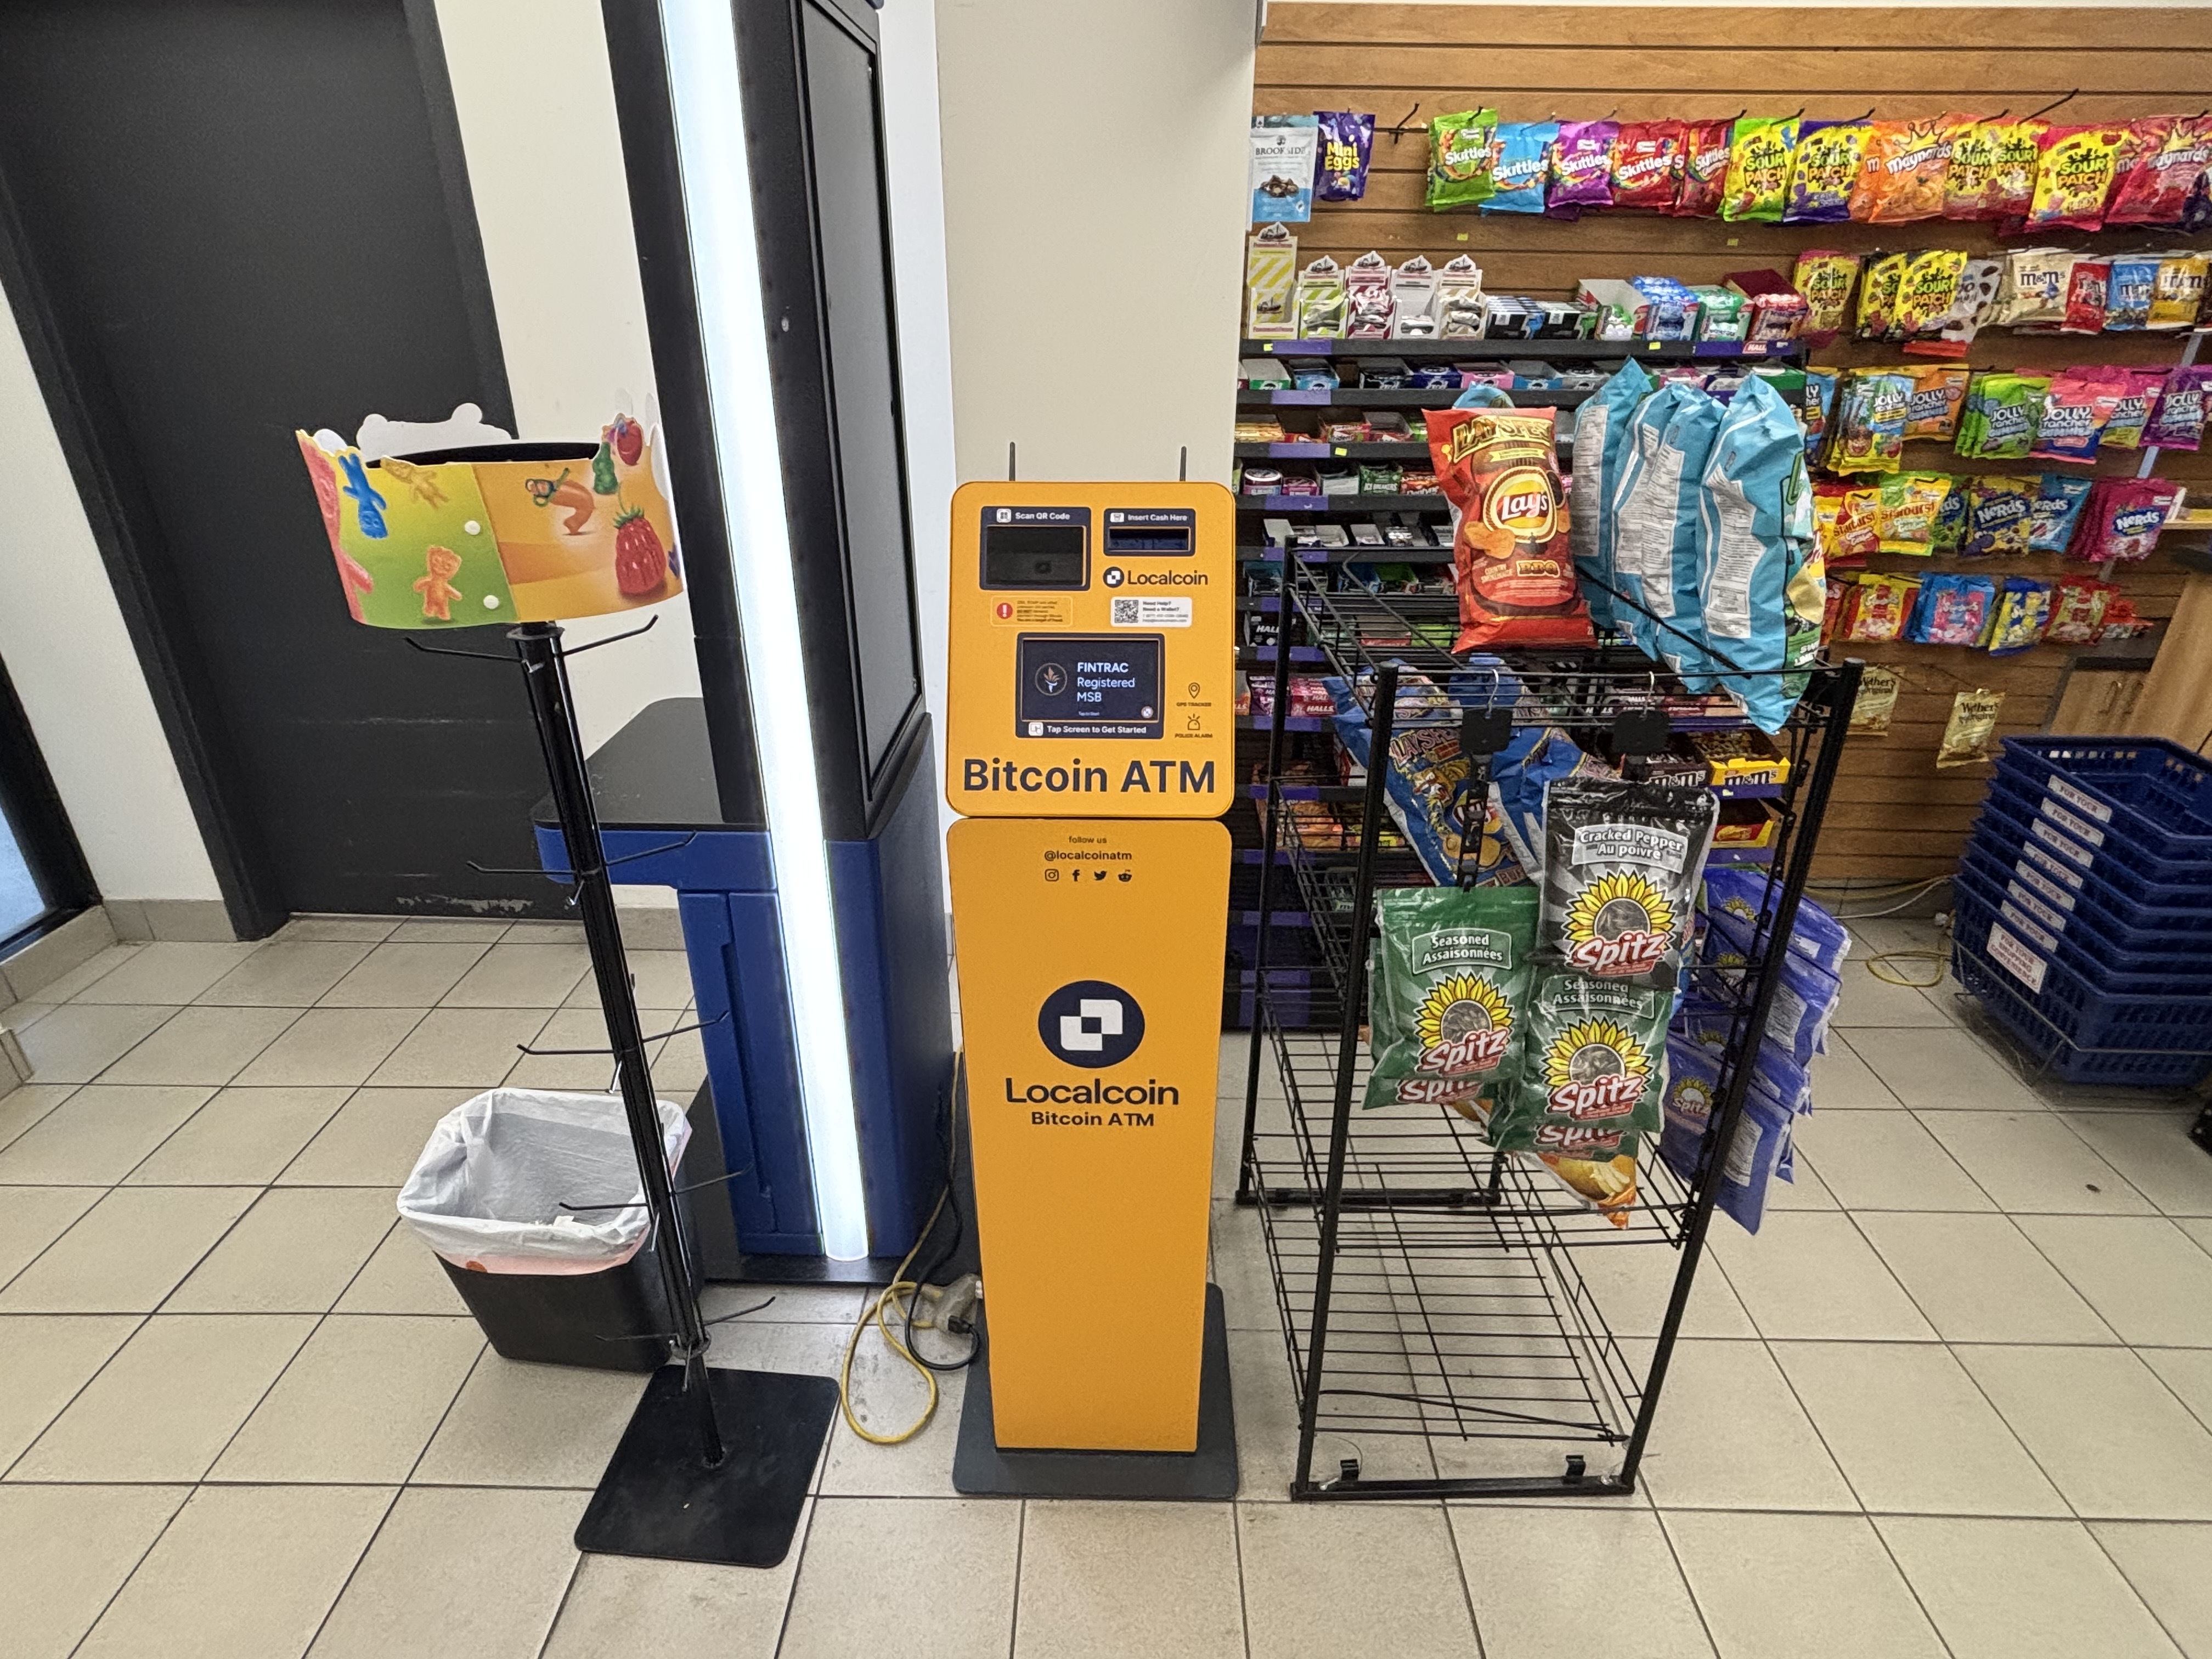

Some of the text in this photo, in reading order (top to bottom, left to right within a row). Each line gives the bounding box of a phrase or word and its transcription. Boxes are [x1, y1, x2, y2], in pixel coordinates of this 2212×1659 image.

[1327, 141, 1358, 157] Mini
[1444, 146, 1492, 165] Skittles
[1999, 149, 2034, 162] SOUR
[1324, 155, 1360, 171] Eggs
[1561, 154, 1613, 176] Skittles
[1695, 147, 1730, 171] Skittles
[1746, 152, 1785, 171] SOUR
[1810, 152, 1850, 167] SOUR
[1953, 150, 1991, 165] SOUR
[1492, 159, 1549, 182] Skittles
[1618, 155, 1672, 180] Skittles
[1809, 165, 1851, 181] PATCH
[1948, 164, 1991, 178] PATCH
[2060, 158, 2107, 175] SOUR
[1745, 166, 1787, 186] PATCH
[2058, 171, 2107, 188] PATCH
[1812, 275, 1846, 289] SOUR
[1883, 281, 1899, 294] SO
[1915, 280, 1951, 294] SOUR
[1810, 289, 1846, 300] PATCH
[1913, 292, 1951, 305] PATCH
[1873, 392, 1904, 407] JOLLY
[1910, 389, 1945, 405] JOLLY
[2115, 397, 2143, 411] OLLY
[2166, 393, 2200, 407] JOLLY
[1991, 406, 2025, 422] JOLLY
[2042, 407, 2091, 421] JOLLY
[2043, 419, 2091, 428] rancher
[1373, 483, 1398, 492] BREAKERS
[1501, 490, 1548, 521] Lay's
[1015, 512, 1071, 521] Scan QR Code
[1127, 514, 1149, 522] Insert
[1519, 562, 1559, 575] BBQ
[1127, 569, 1208, 585] Localcoin
[1077, 662, 1128, 673] FINTRAC
[1077, 677, 1135, 688] Registered
[1077, 692, 1102, 702] MSB
[1047, 725, 1147, 735] Tap Screen to Get Started
[964, 757, 1215, 793] Bitcoin ATM
[2060, 786, 2097, 813] FOR YOUR
[2052, 809, 2090, 836] FOR YOUR
[1069, 836, 1094, 844] follow
[1580, 829, 1684, 851] Cracked Pepper
[2044, 830, 2058, 843] FOR
[1044, 850, 1132, 862] @localcoinatm
[1596, 844, 1662, 860] Au poivre
[1431, 934, 1489, 948] Seasoned
[1422, 946, 1504, 964] Assaisonnées
[1576, 933, 1667, 972] Spitz
[1564, 979, 1629, 992] Seasoned
[1553, 993, 1643, 1010] Assaisonnées
[1423, 1030, 1509, 1071] Spitz
[1005, 1077, 1180, 1105] Localcoin
[1555, 1075, 1644, 1116] Spitz
[1031, 1111, 1154, 1127] Bitcoin ATM
